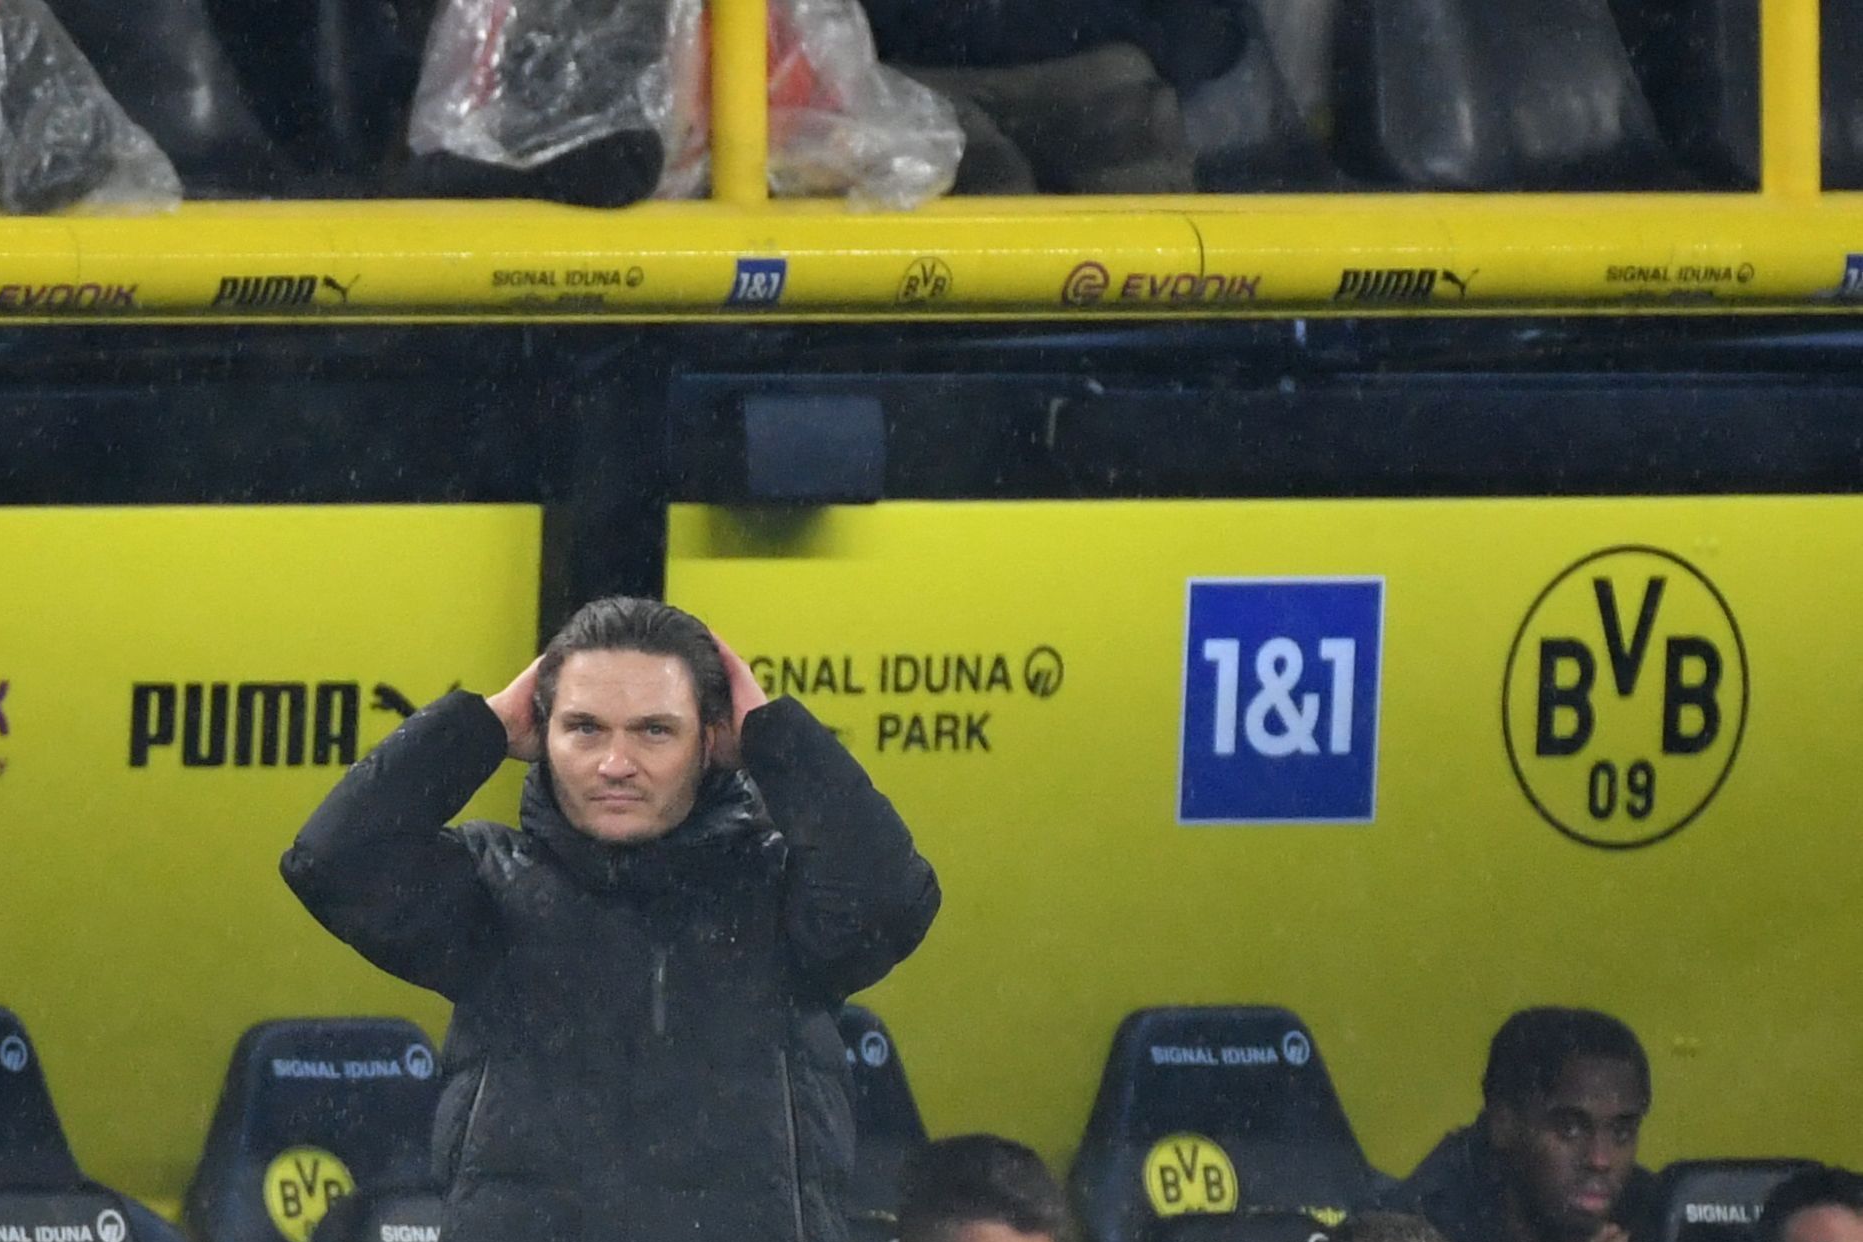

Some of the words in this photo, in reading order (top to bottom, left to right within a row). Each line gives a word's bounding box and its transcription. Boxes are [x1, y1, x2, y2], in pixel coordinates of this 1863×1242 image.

[492, 270, 556, 286] SIGNAL
[565, 270, 621, 286] IDUNA
[738, 273, 781, 298] 1&1
[1119, 273, 1262, 299] EVONIK
[1338, 269, 1436, 298] PUMA
[1605, 266, 1669, 282] SIGNAL
[1676, 266, 1732, 282] IDUNA
[212, 276, 317, 305] PUMA
[749, 655, 865, 694] GNAL
[880, 654, 1013, 693] IDUNA
[1535, 576, 1723, 756] BVB
[1203, 637, 1356, 756] 1&1
[130, 681, 360, 768] PUMA
[878, 713, 992, 752] PARK
[1588, 759, 1656, 822] 09
[272, 1058, 341, 1079] SIGNAL
[343, 1060, 402, 1079] IDUNA
[1150, 1046, 1218, 1066] SIGNAL
[1222, 1047, 1278, 1065] IDUNA
[1159, 1144, 1226, 1205] BVB
[1686, 1203, 1752, 1223] SIGNAL
[381, 1225, 441, 1242] SIGNA
